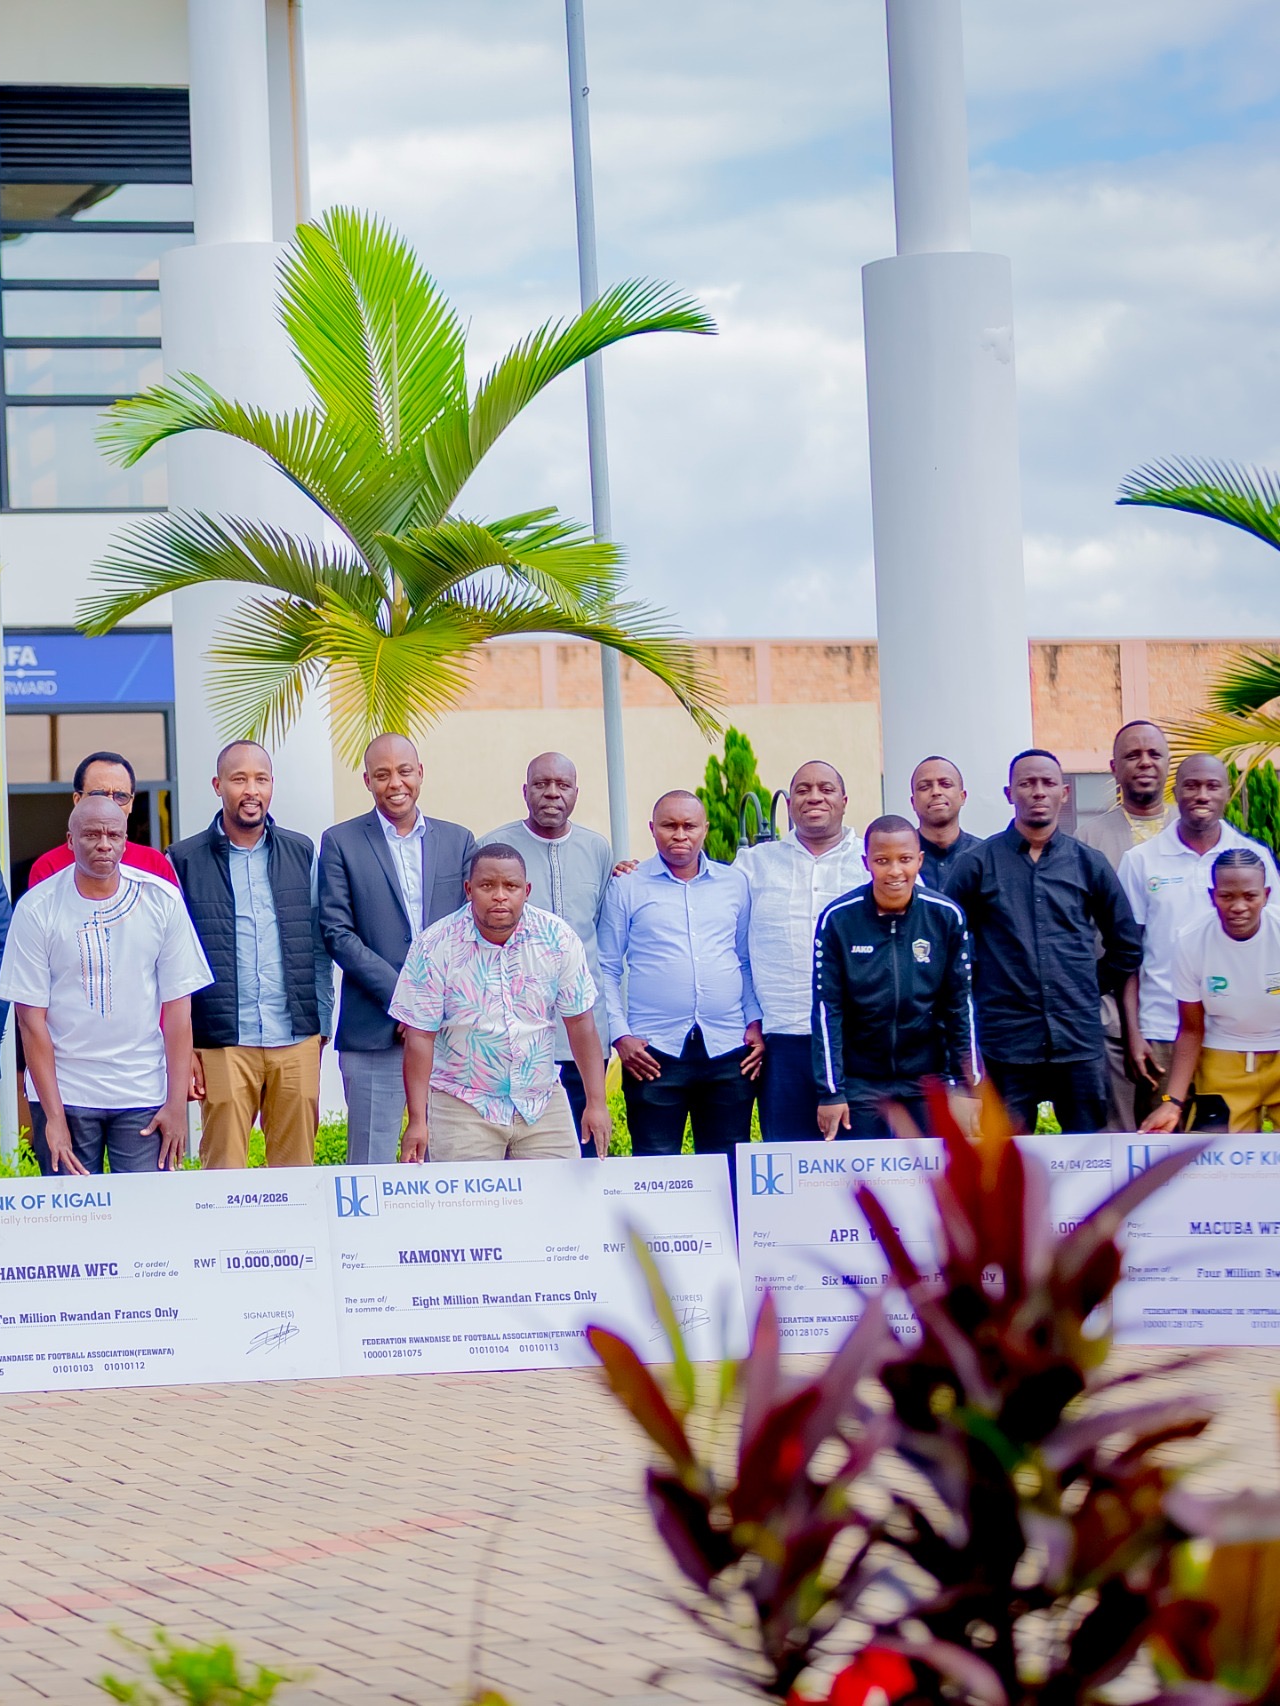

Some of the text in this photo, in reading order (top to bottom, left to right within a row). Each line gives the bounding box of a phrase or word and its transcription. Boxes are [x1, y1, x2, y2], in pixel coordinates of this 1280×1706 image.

[4, 680, 58, 696] RWARD
[851, 945, 874, 953] JAKO
[1188, 1151, 1254, 1165] ANK OF
[798, 1157, 939, 1174] BANK OF KIGALI
[382, 1177, 522, 1196] BANK OF KIGALI
[634, 1180, 693, 1192] 24/04/2026
[798, 1179, 851, 1188] Financially
[21, 1195, 46, 1210] OF
[52, 1192, 111, 1209] KIGALI
[227, 1193, 288, 1206] 24/04/2026
[384, 1197, 523, 1210] Financially transforming lives
[24, 1214, 87, 1224] transforming
[91, 1212, 112, 1221] lives
[1190, 1222, 1253, 1235] MACUBA
[830, 1229, 859, 1242] APR
[603, 1240, 712, 1254] RWF 000,000/=
[194, 1254, 313, 1269] RWF 10,000,000/=
[399, 1248, 502, 1264] KAMONYI WFC
[85, 1263, 118, 1277] WFC
[1197, 1268, 1260, 1278] Four Million
[821, 1276, 838, 1285] Six
[842, 1275, 877, 1285] Million
[412, 1290, 597, 1309] Eight Million Rwandan Francs Only
[20, 1313, 57, 1323] Million
[60, 1311, 111, 1322] Rwandan
[115, 1309, 151, 1319] Francs
[155, 1307, 179, 1319] Only
[244, 1311, 294, 1320] SIGNATURE(S)
[362, 1334, 500, 1346] FEDERATION RWANDAISE DE FOOTBALL
[48, 1352, 85, 1361] FOOTBALL
[87, 1348, 174, 1358] ASSOCIATION(FERWAFA)
[363, 1344, 559, 1359] 100001281075 01010104 01010113
[53, 1364, 94, 1373] 01010103
[104, 1362, 145, 1371] 01010112
